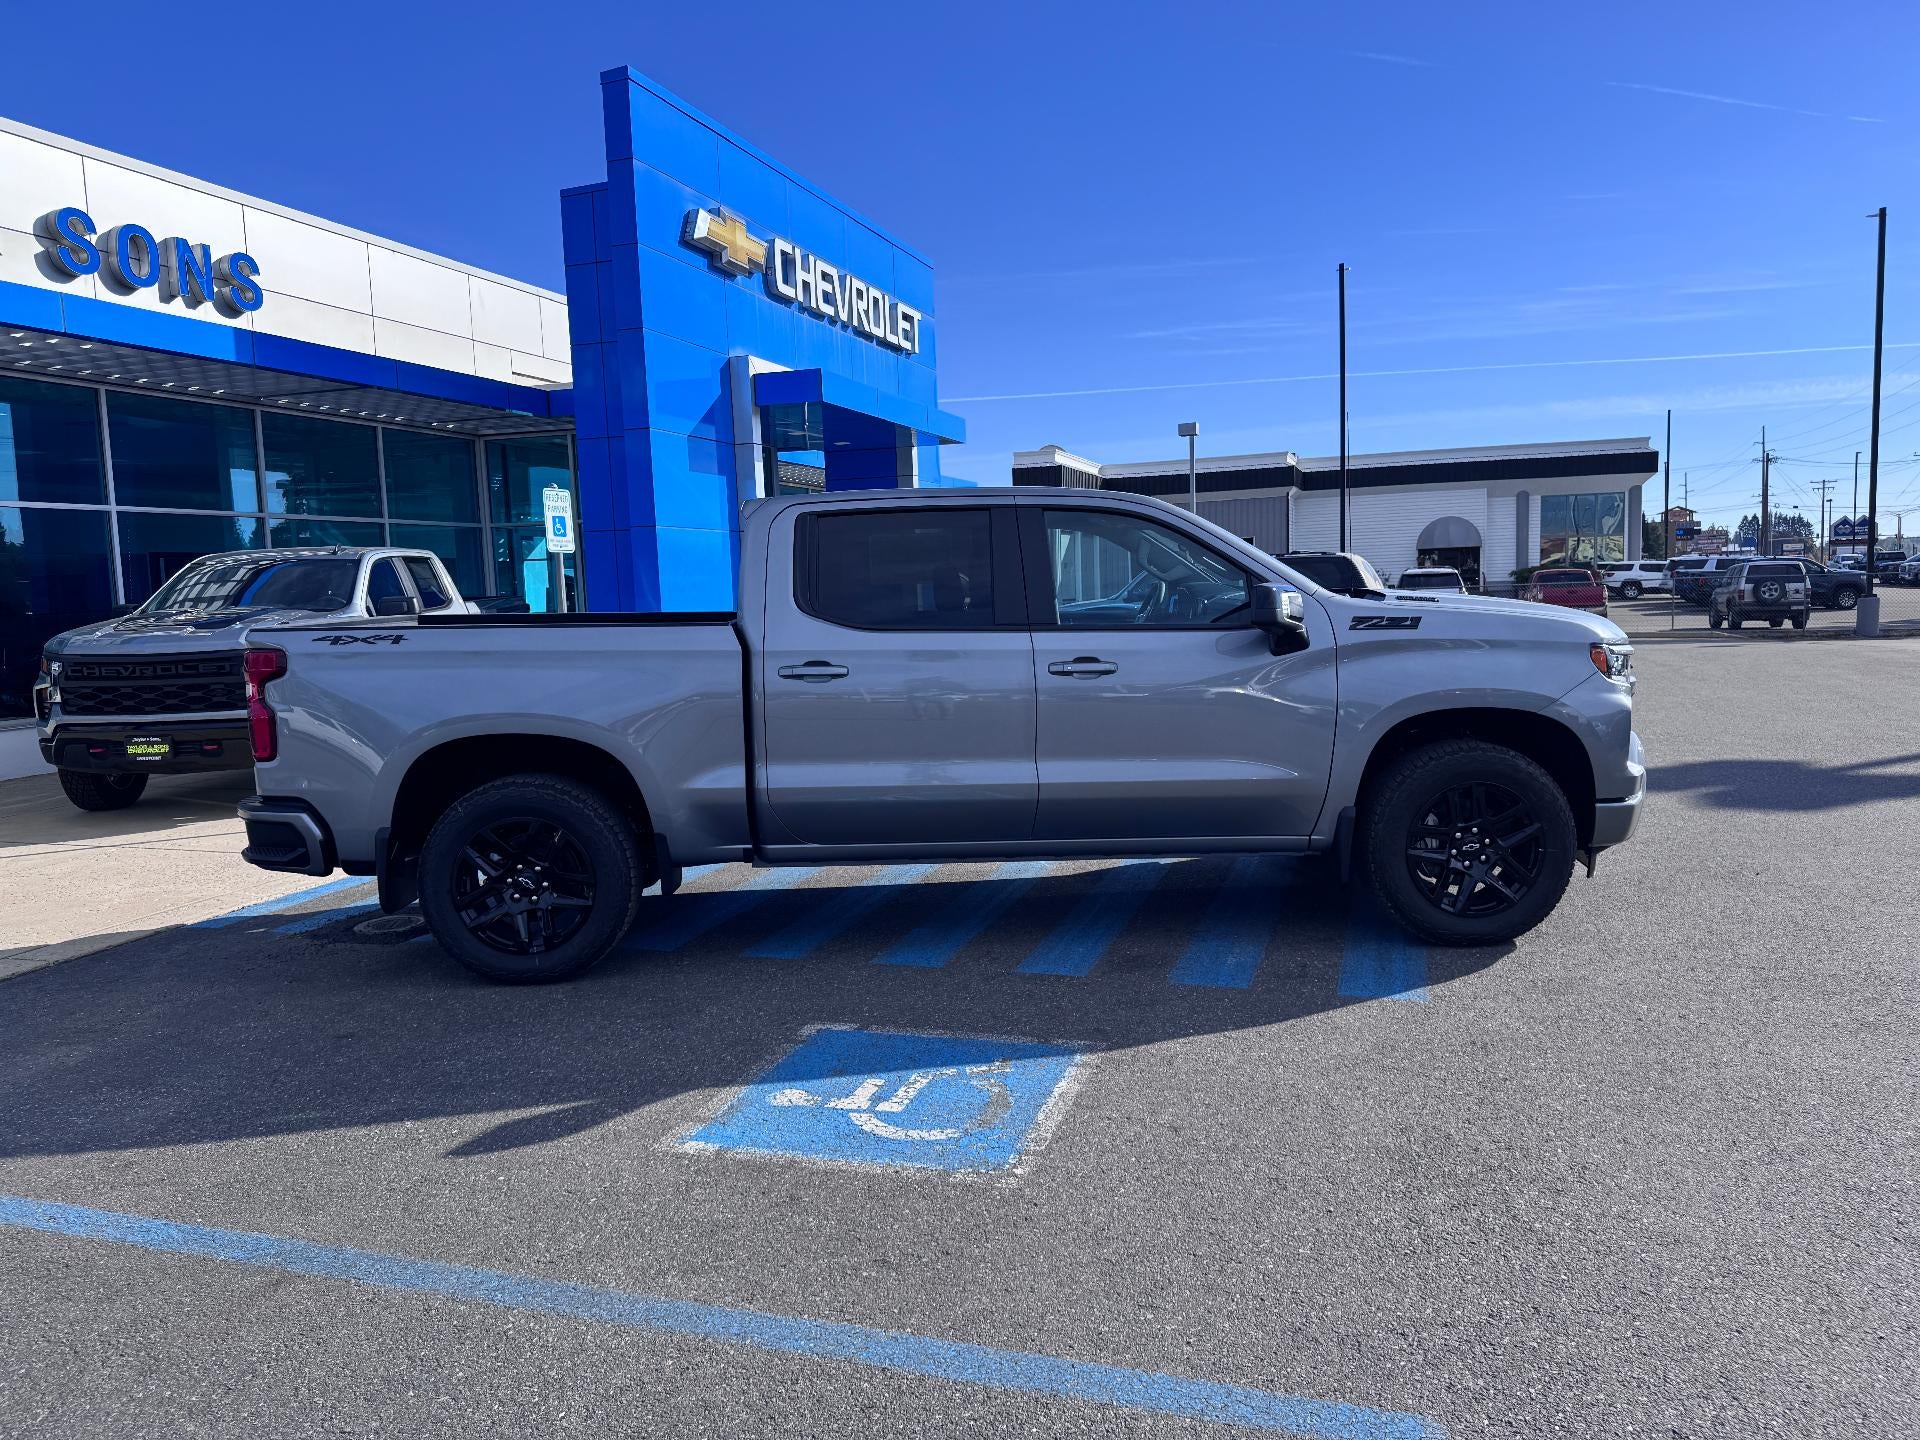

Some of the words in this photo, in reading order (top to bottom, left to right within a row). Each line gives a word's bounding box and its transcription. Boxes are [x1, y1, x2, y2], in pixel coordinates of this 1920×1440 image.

[46, 206, 264, 313] SONS
[773, 237, 922, 354] CHEVROLET
[1348, 615, 1423, 631] Z71
[67, 662, 237, 678] CHEVROLET
